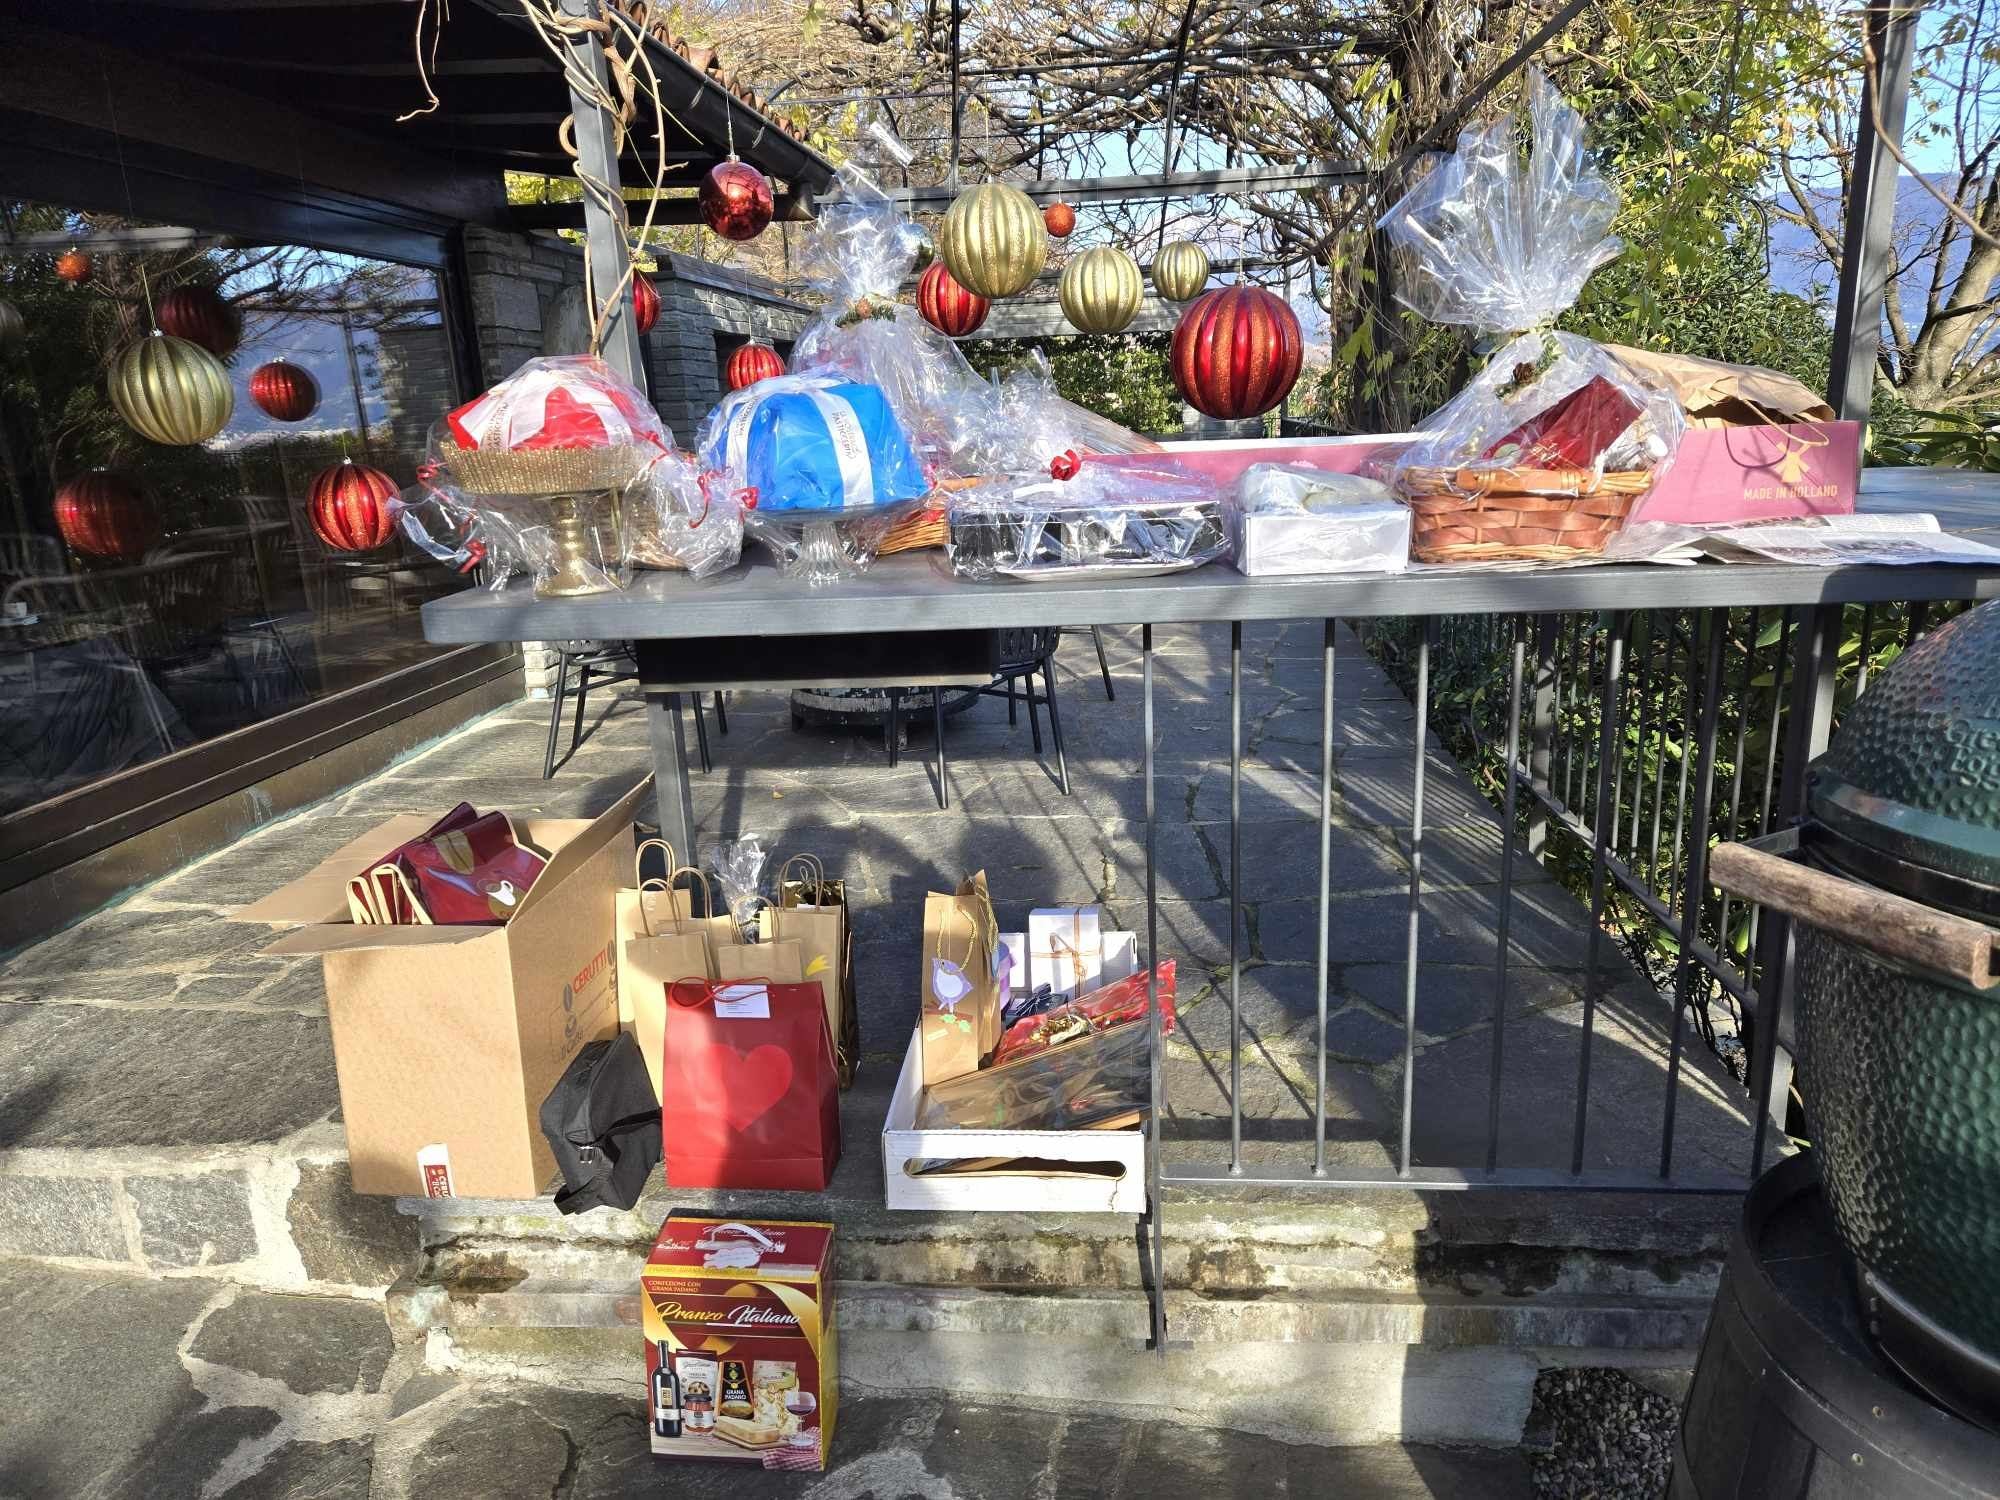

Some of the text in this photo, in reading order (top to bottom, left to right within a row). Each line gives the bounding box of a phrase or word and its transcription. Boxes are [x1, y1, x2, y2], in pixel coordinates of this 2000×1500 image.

[1744, 485, 1838, 500] MADE IN HOLLAND
[573, 948, 607, 993] CERUTTI
[655, 1301, 800, 1326] Pranzo Italiano
